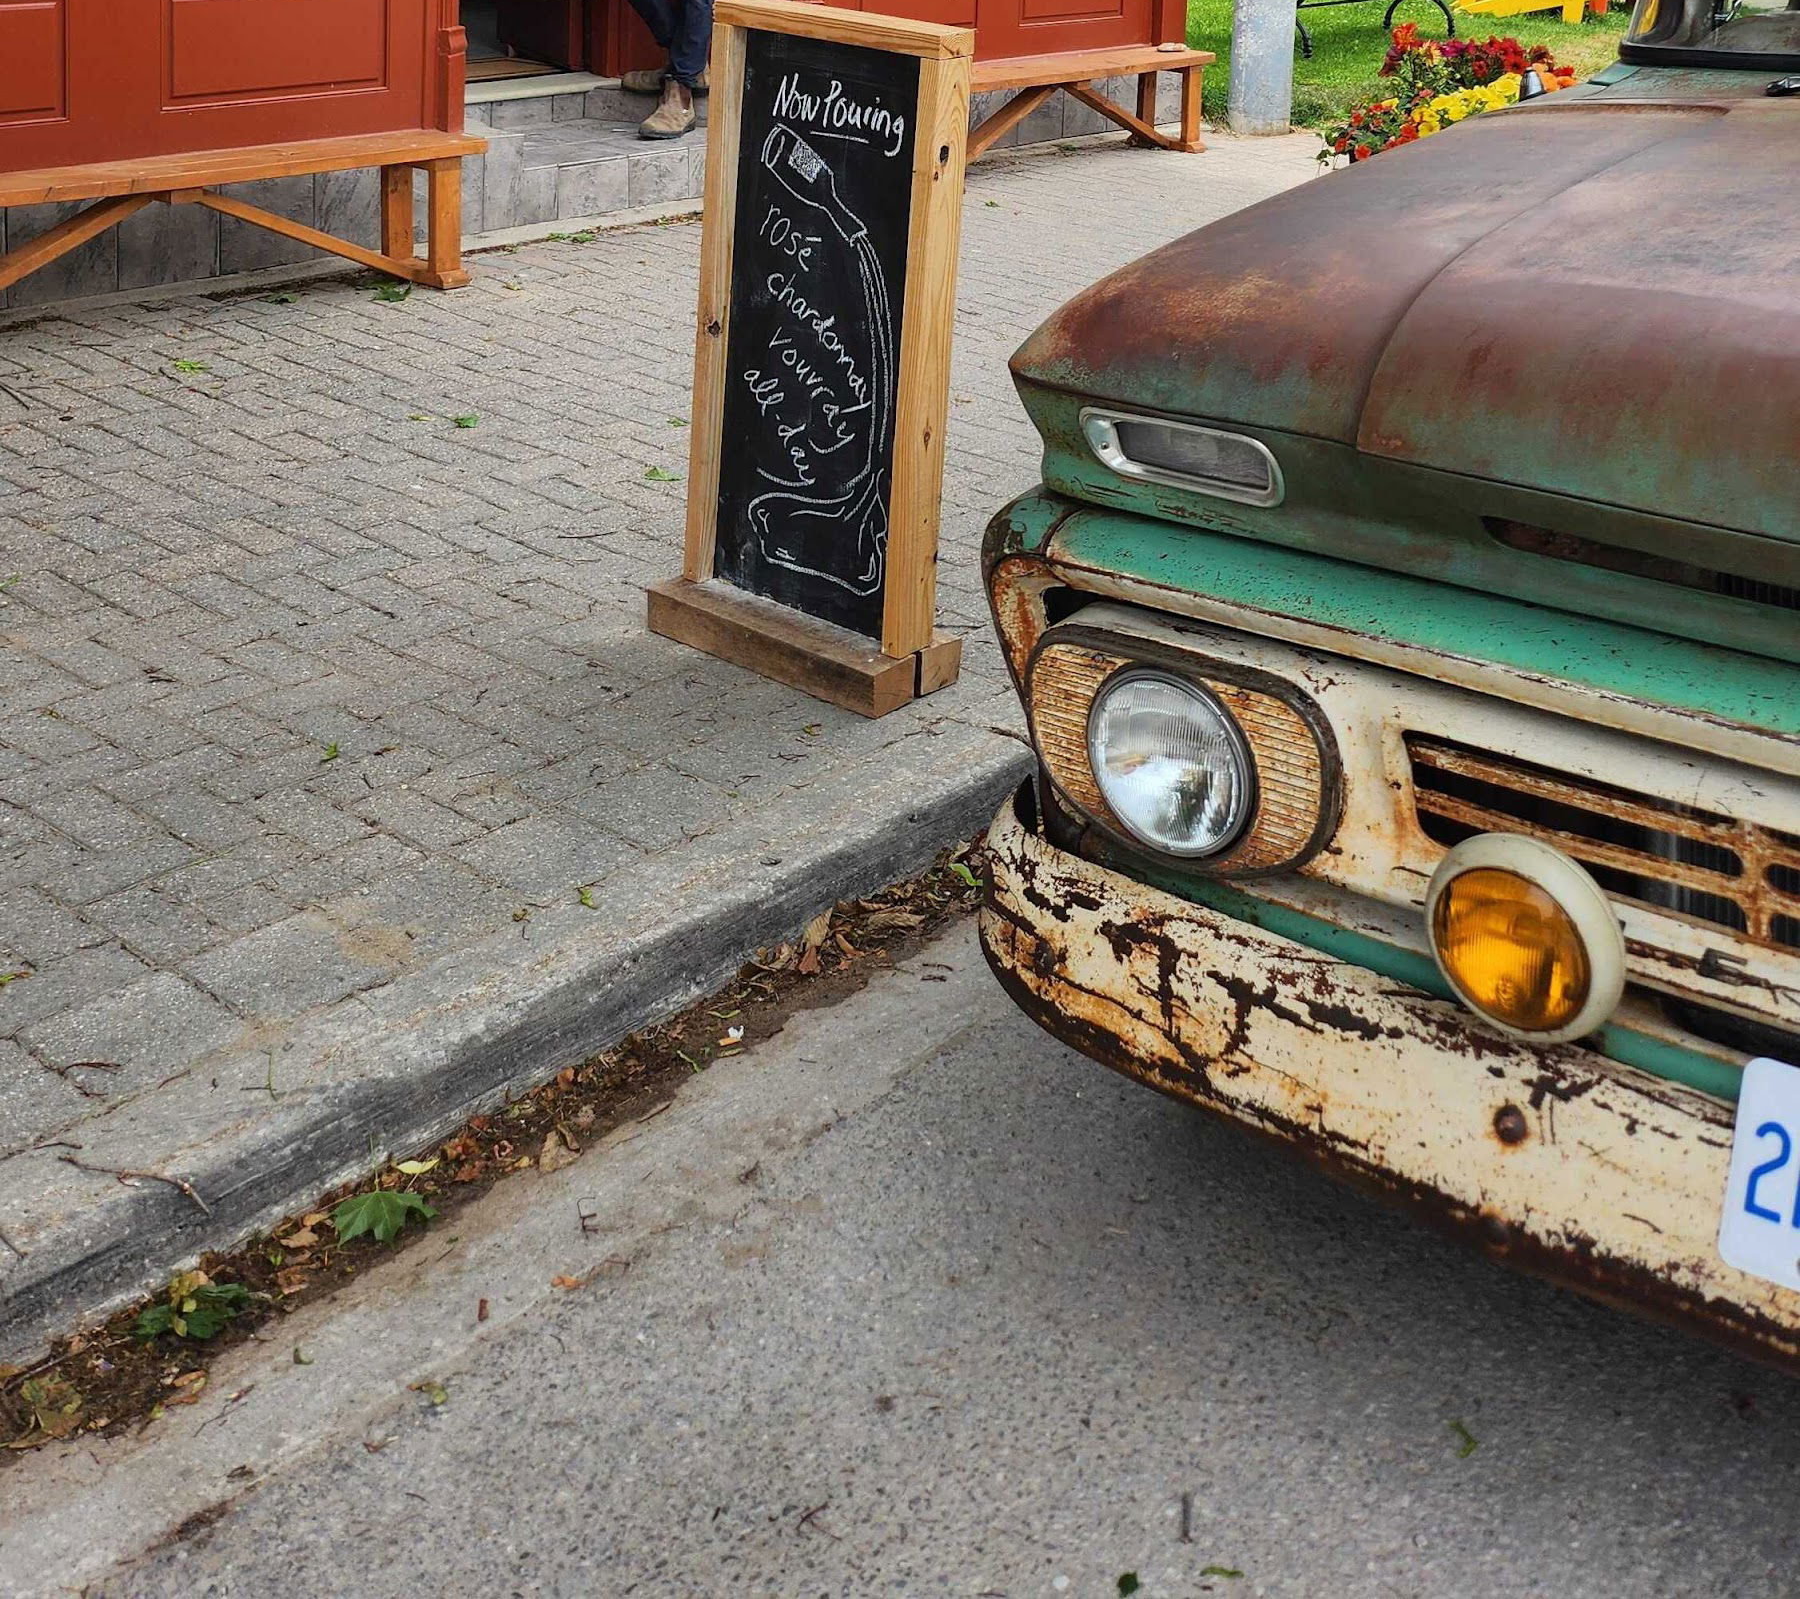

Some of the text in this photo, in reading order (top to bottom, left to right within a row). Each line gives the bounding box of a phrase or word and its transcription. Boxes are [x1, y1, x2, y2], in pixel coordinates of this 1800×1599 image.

[772, 72, 905, 157] Now Pouring
[1744, 1121, 1800, 1229] 2
